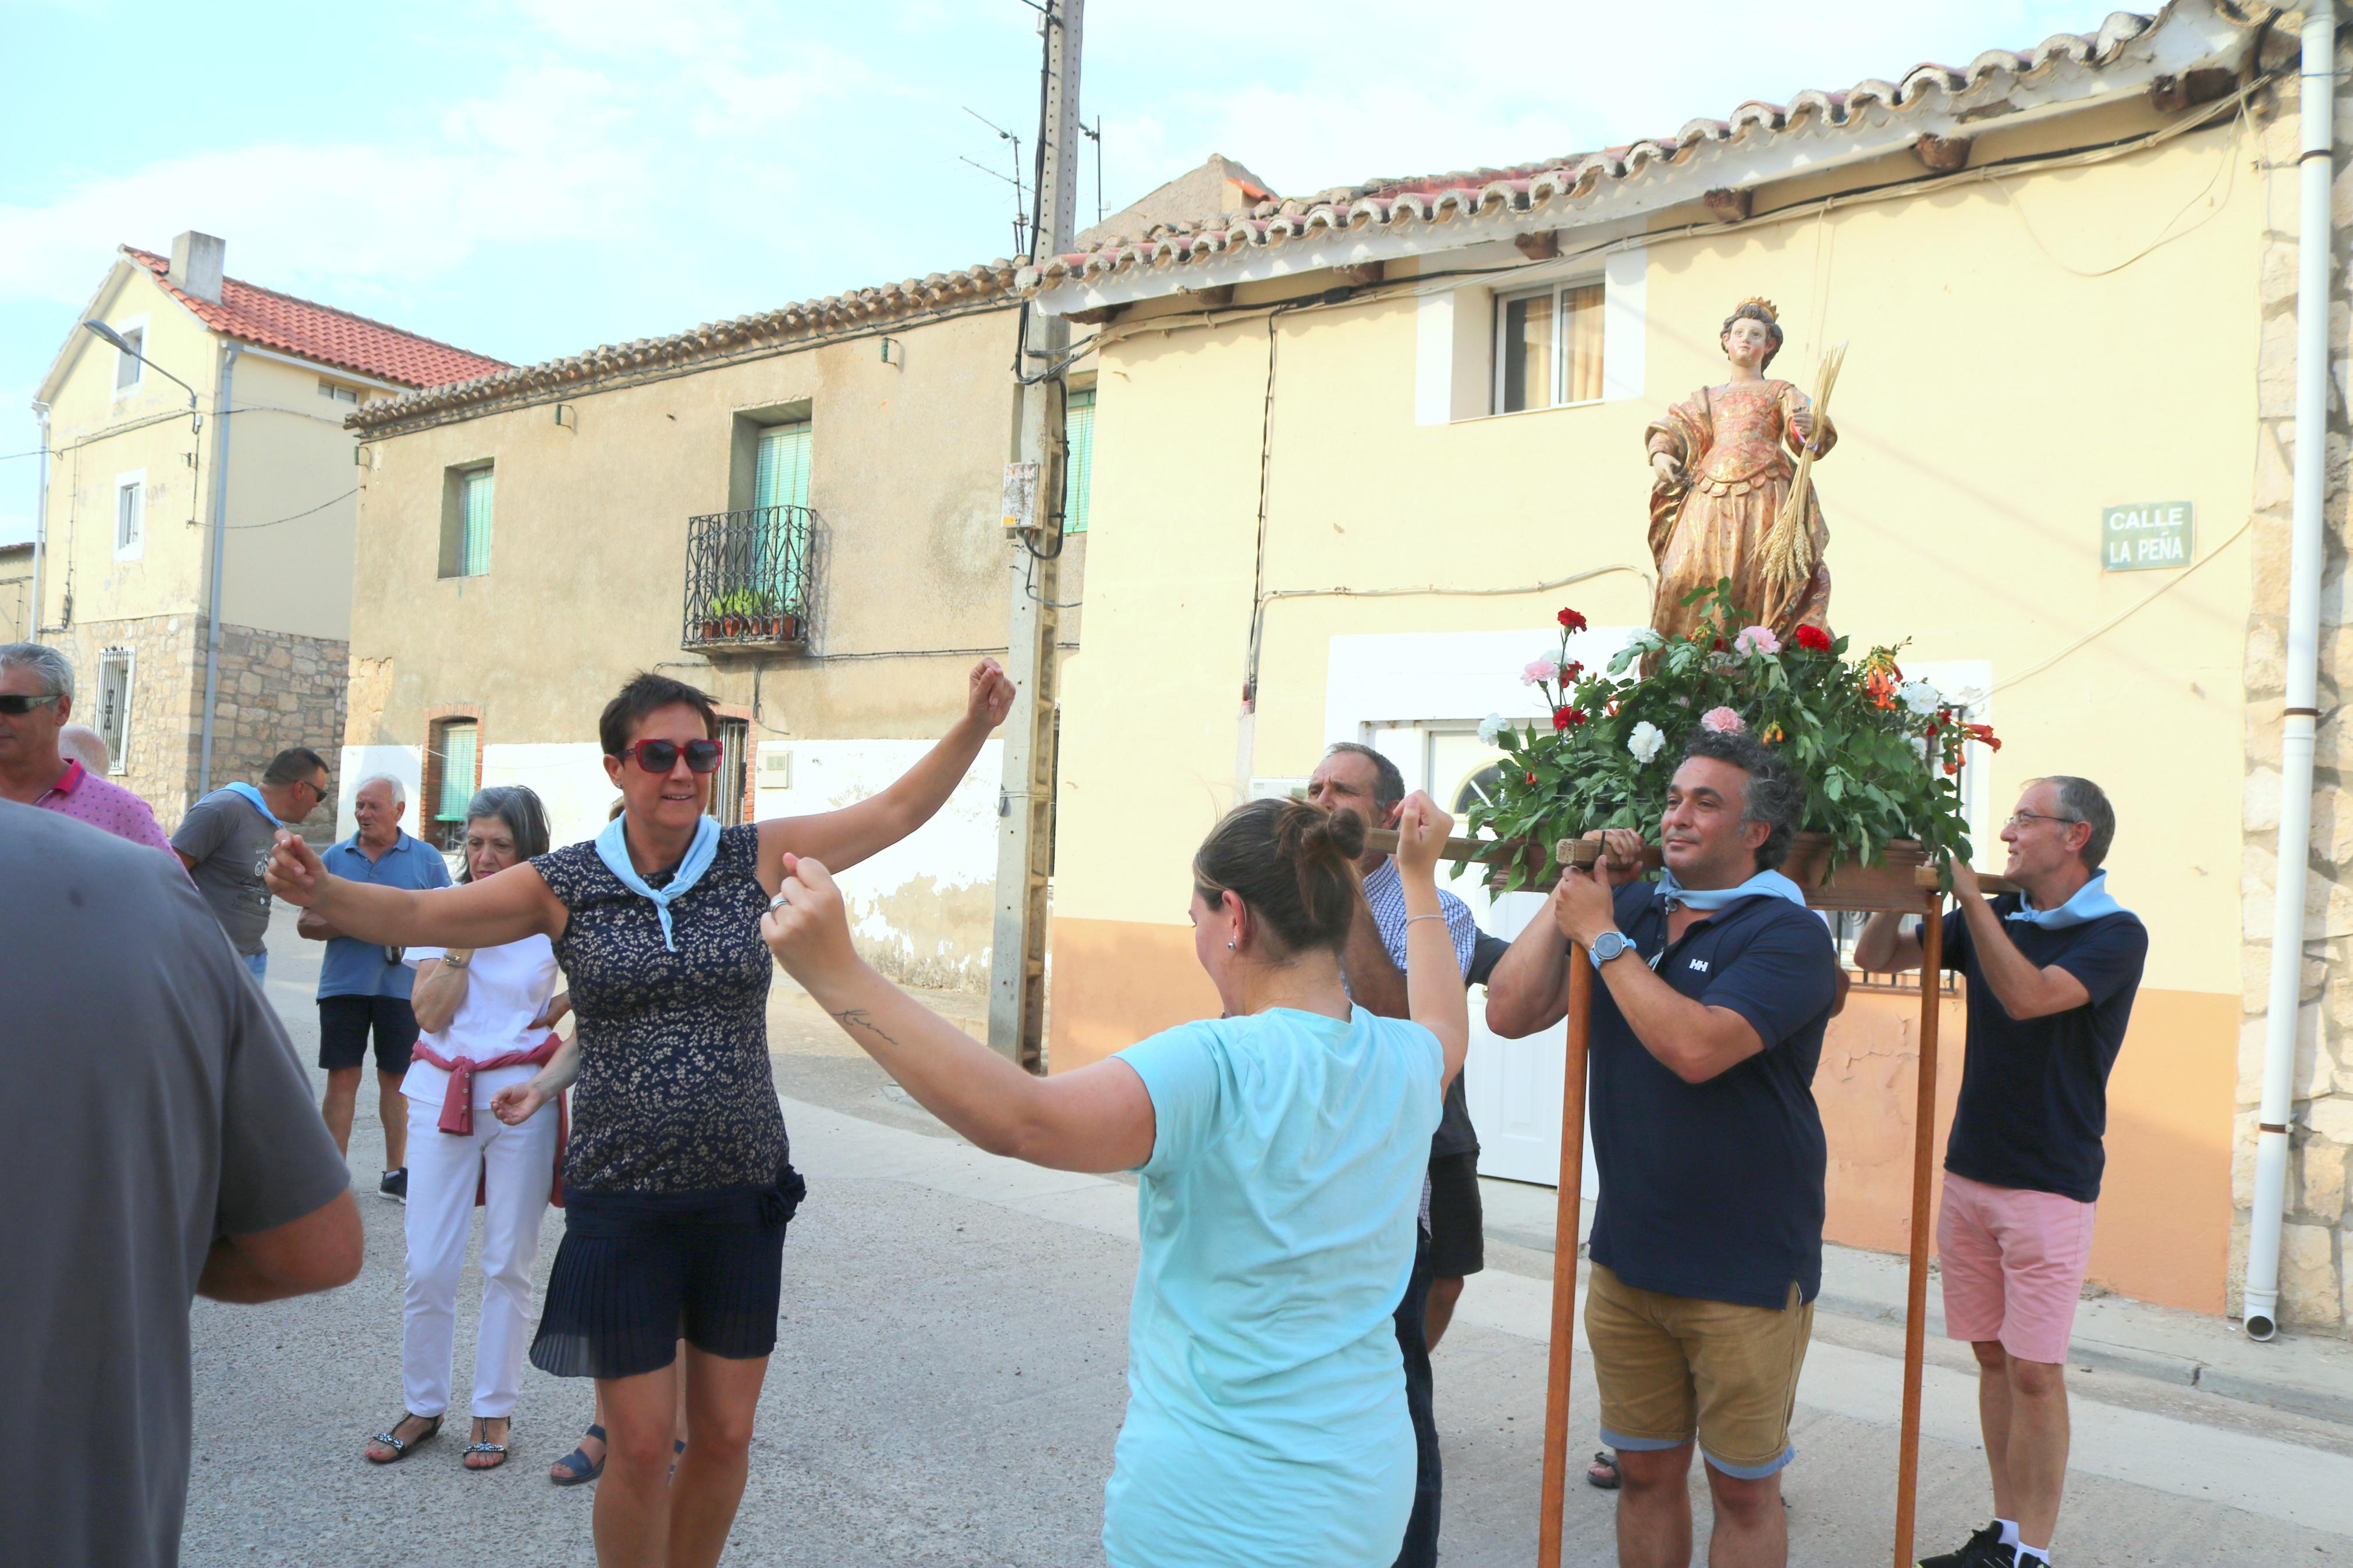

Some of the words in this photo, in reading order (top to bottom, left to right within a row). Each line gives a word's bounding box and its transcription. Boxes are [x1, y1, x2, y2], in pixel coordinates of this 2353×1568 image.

[2109, 507, 2184, 530] CALLE
[2109, 541, 2131, 563] LA
[2138, 531, 2184, 561] PEÑA
[1689, 959, 1708, 972] HH
